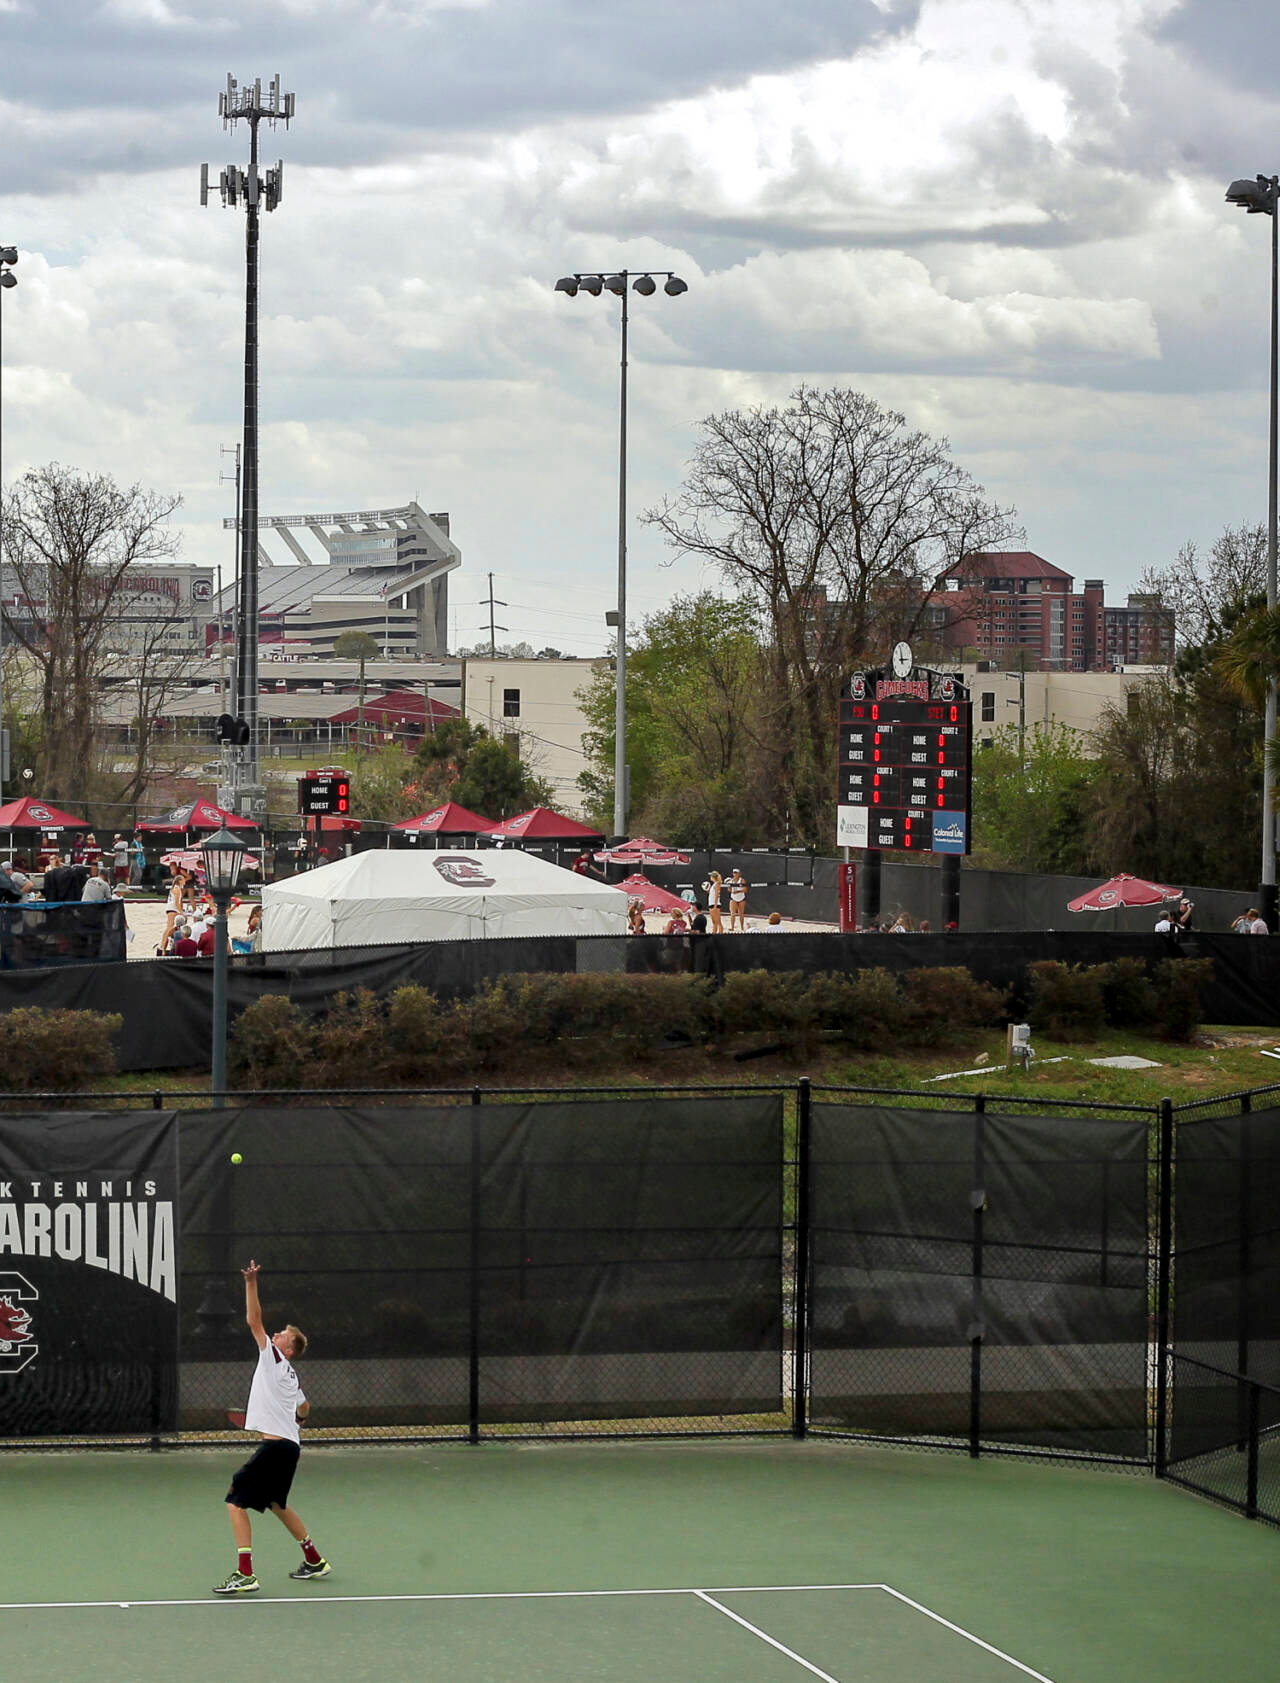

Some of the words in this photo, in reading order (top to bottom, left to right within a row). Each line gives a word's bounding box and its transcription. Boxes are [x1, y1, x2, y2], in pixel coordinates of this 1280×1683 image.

[876, 680, 928, 701] GAMECOCKS
[850, 734, 863, 743] HOME
[913, 736, 926, 745] HOME
[849, 751, 863, 760] GUEST
[912, 753, 927, 762] GUEST
[850, 776, 862, 784] HOME
[913, 778, 926, 787] HOME
[338, 784, 347, 796] 0
[848, 792, 863, 801] GUEST
[911, 795, 926, 804] GUEST
[338, 799, 347, 811] 0
[880, 818, 893, 828] HOME
[879, 835, 894, 844] GUEST
[32, 1181, 156, 1197] TENNIS
